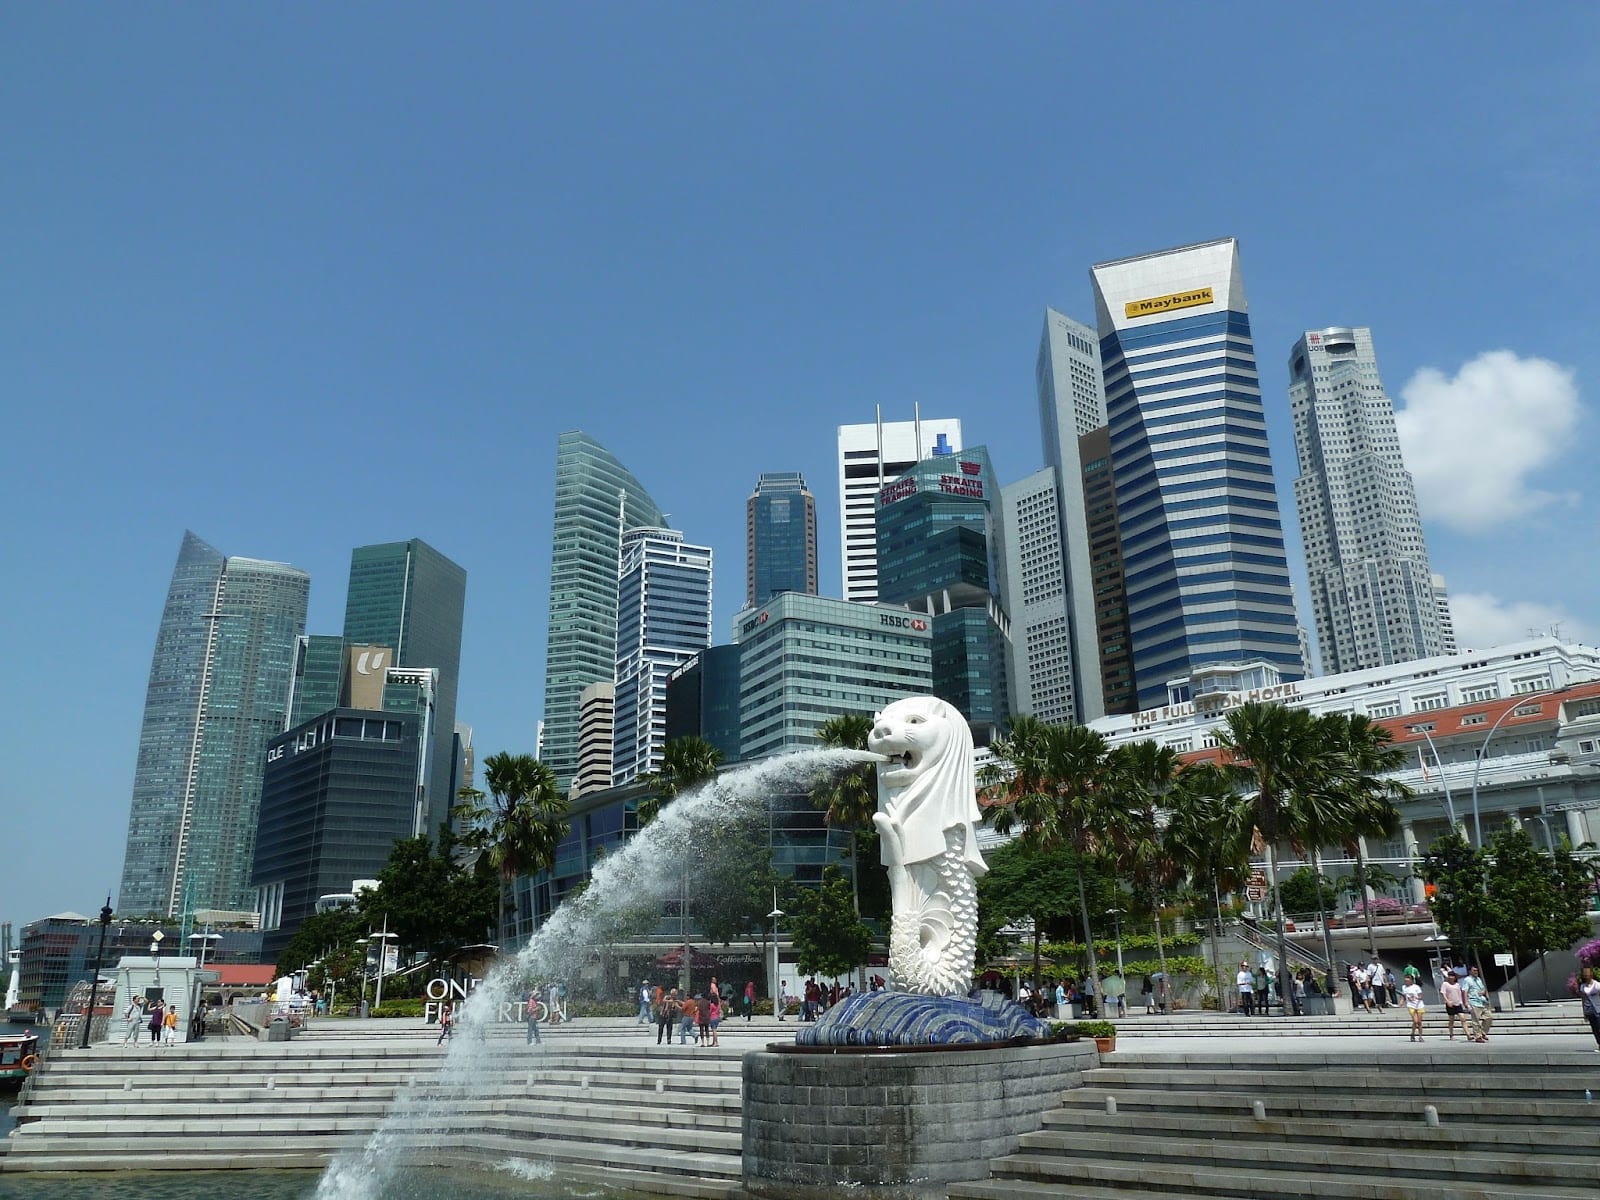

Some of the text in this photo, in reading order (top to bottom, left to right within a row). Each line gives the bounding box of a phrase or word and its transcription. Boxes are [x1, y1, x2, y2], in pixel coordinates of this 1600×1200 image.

[1140, 291, 1211, 310] Maybank
[880, 476, 915, 496] STRAITS
[939, 483, 984, 498] TRADING
[940, 474, 983, 489] STRAITS
[881, 485, 918, 505] TRADING
[743, 616, 759, 634] HSBC
[880, 613, 911, 629] HSBC
[1132, 683, 1301, 726] THE FULLERTON HOTEL
